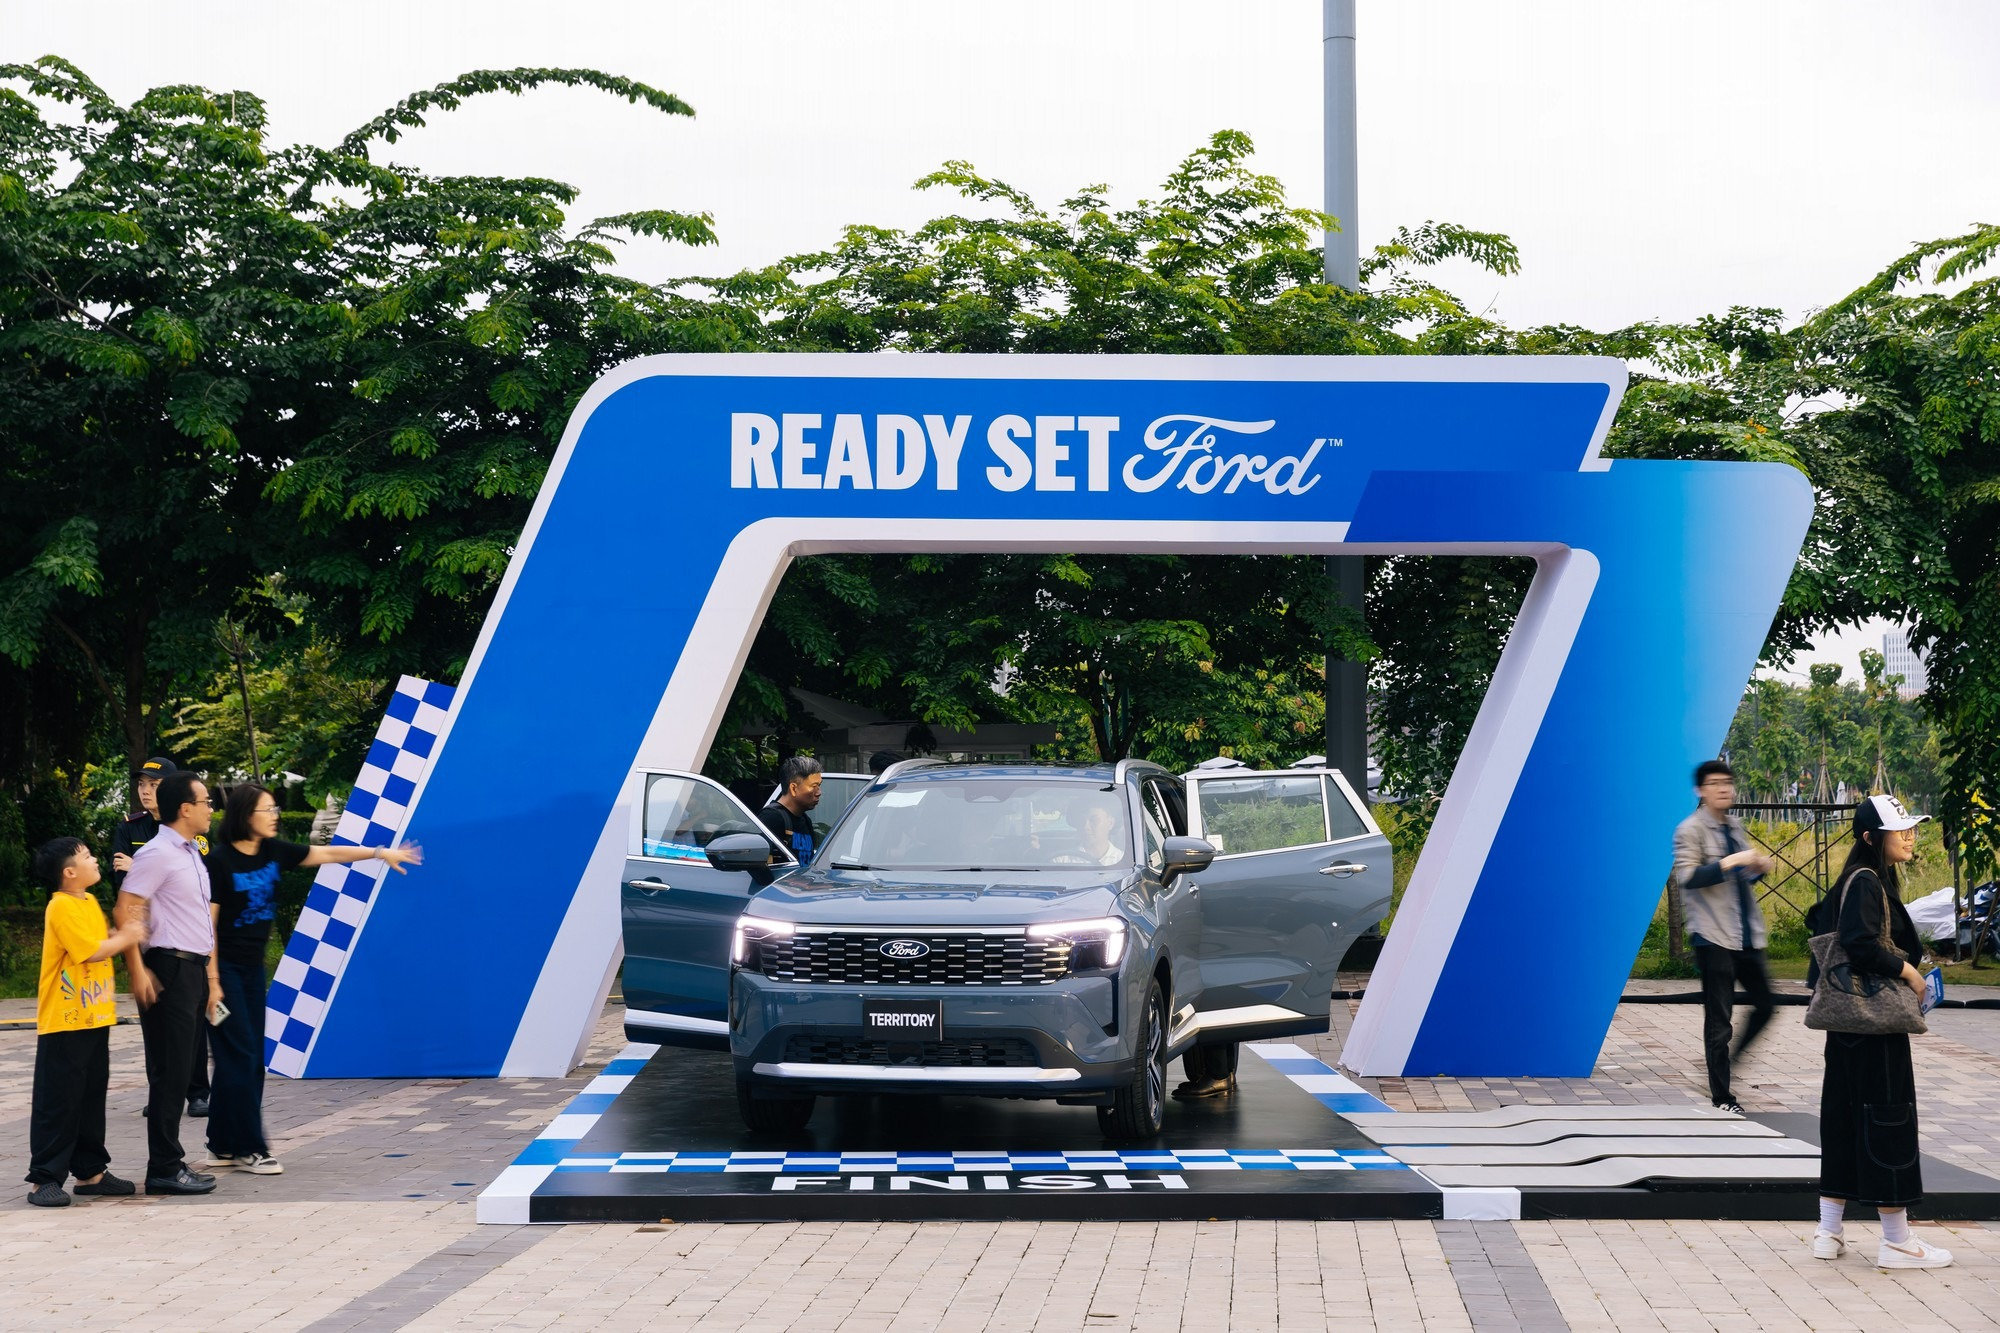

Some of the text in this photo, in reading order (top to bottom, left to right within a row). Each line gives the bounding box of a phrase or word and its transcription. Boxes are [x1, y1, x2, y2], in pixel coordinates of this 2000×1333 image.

[731, 412, 1343, 496] READY SET Ford TM
[889, 941, 919, 956] Ford
[869, 1012, 936, 1027] TERRITORY
[771, 1175, 1190, 1191] FINISH
